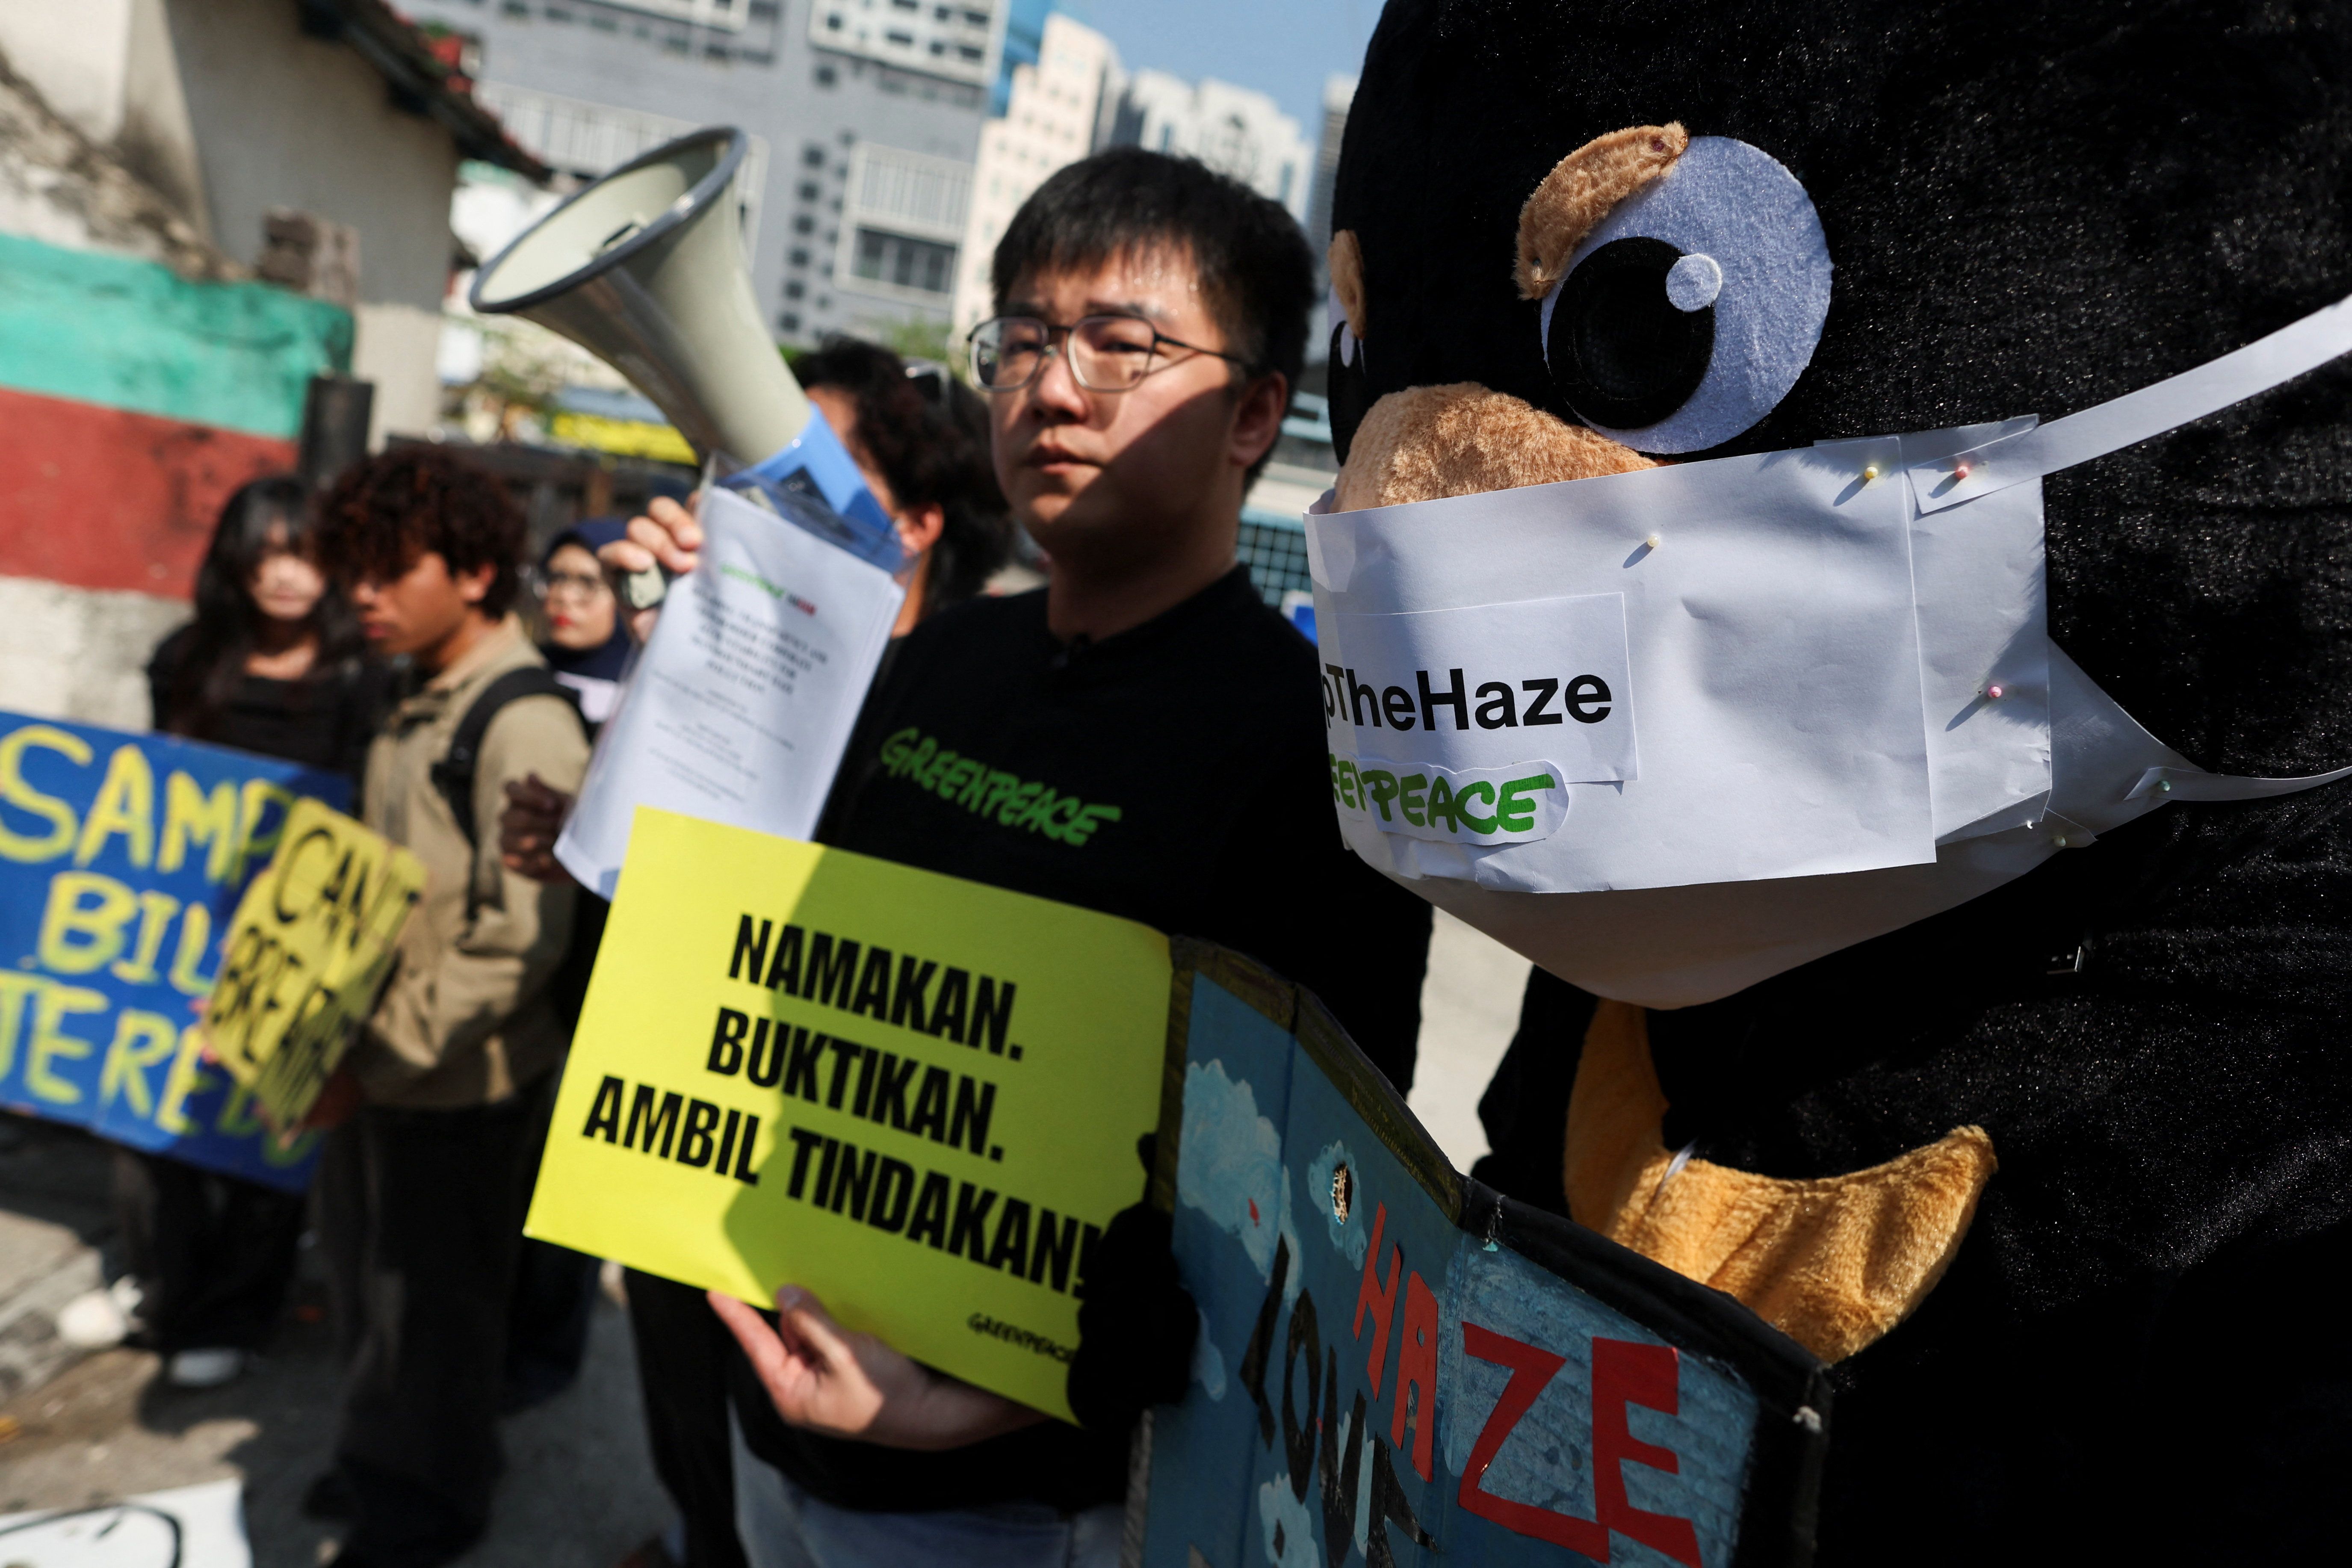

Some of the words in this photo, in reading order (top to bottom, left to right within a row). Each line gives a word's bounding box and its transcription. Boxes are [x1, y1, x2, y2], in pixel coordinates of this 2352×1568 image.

[880, 726, 1122, 847] GREENPEACE
[727, 913, 1023, 1061] NAMAKAN.
[581, 1075, 764, 1187] AMBIL
[706, 1006, 1004, 1163] BUKTIKAN.
[1352, 1201, 1702, 1568] HAZE
